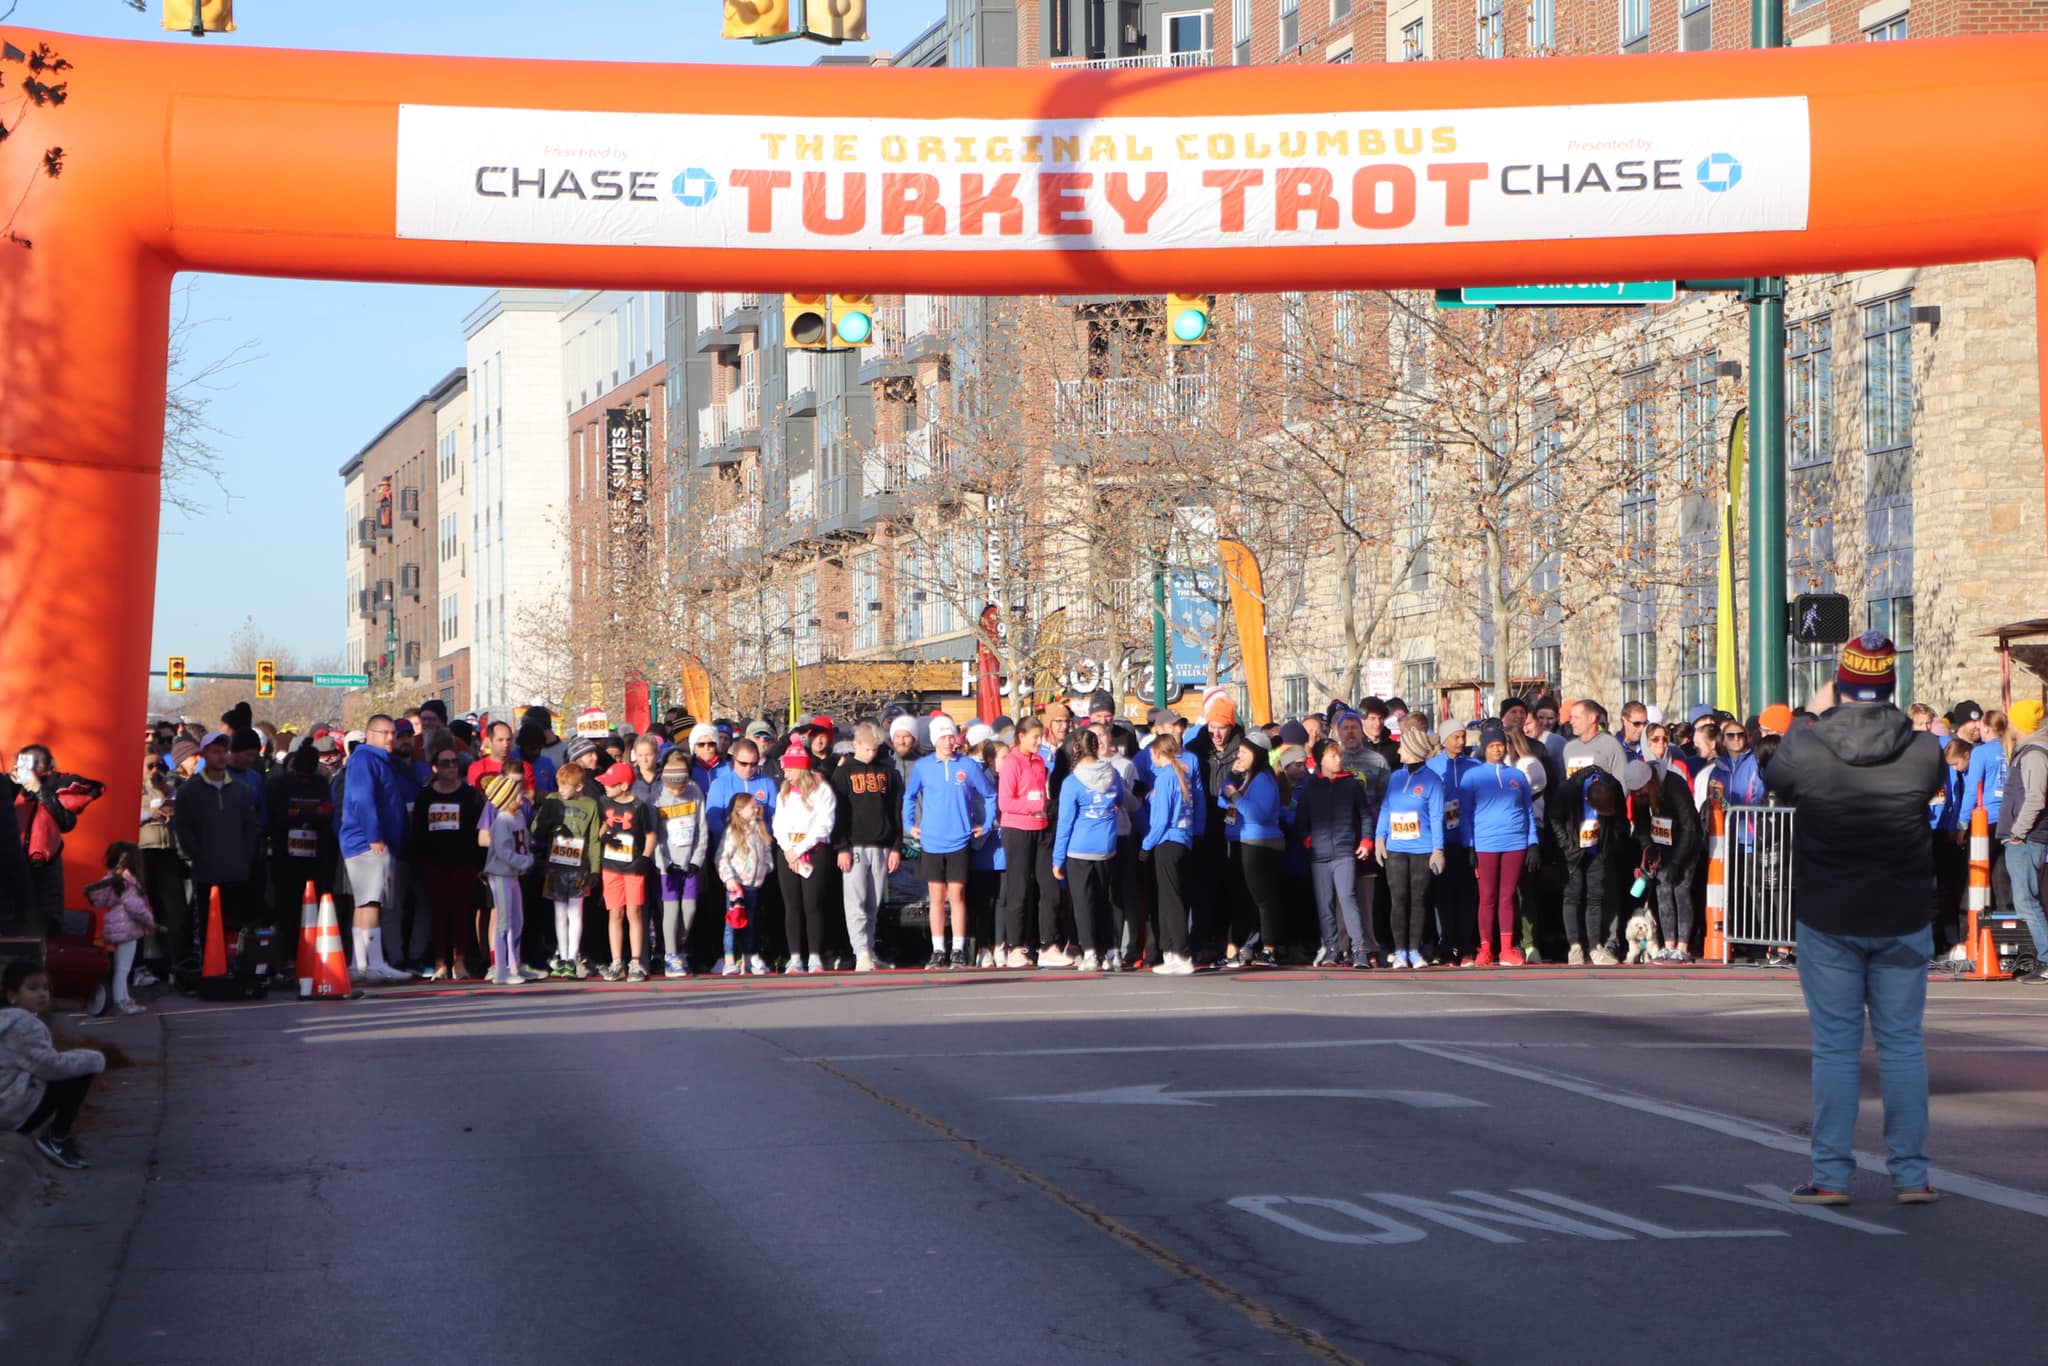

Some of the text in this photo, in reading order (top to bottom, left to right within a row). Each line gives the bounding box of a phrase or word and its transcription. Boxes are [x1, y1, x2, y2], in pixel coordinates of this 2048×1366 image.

[544, 144, 629, 160] Presented by
[762, 127, 1457, 162] THE ORIGINAL COLUMBUS
[1568, 138, 1654, 153] Presented by
[475, 167, 659, 202] CHASE
[1501, 159, 1684, 197] CHASE
[730, 162, 1489, 236] TURKEY TROT
[611, 426, 627, 489] SUITES
[578, 720, 606, 731] 6458
[850, 772, 887, 793] USC
[429, 811, 458, 822] 3234
[1391, 821, 1416, 833] 4349
[512, 829, 528, 855] H
[552, 845, 581, 858] 4506
[1227, 1184, 1907, 1245] ONLY
